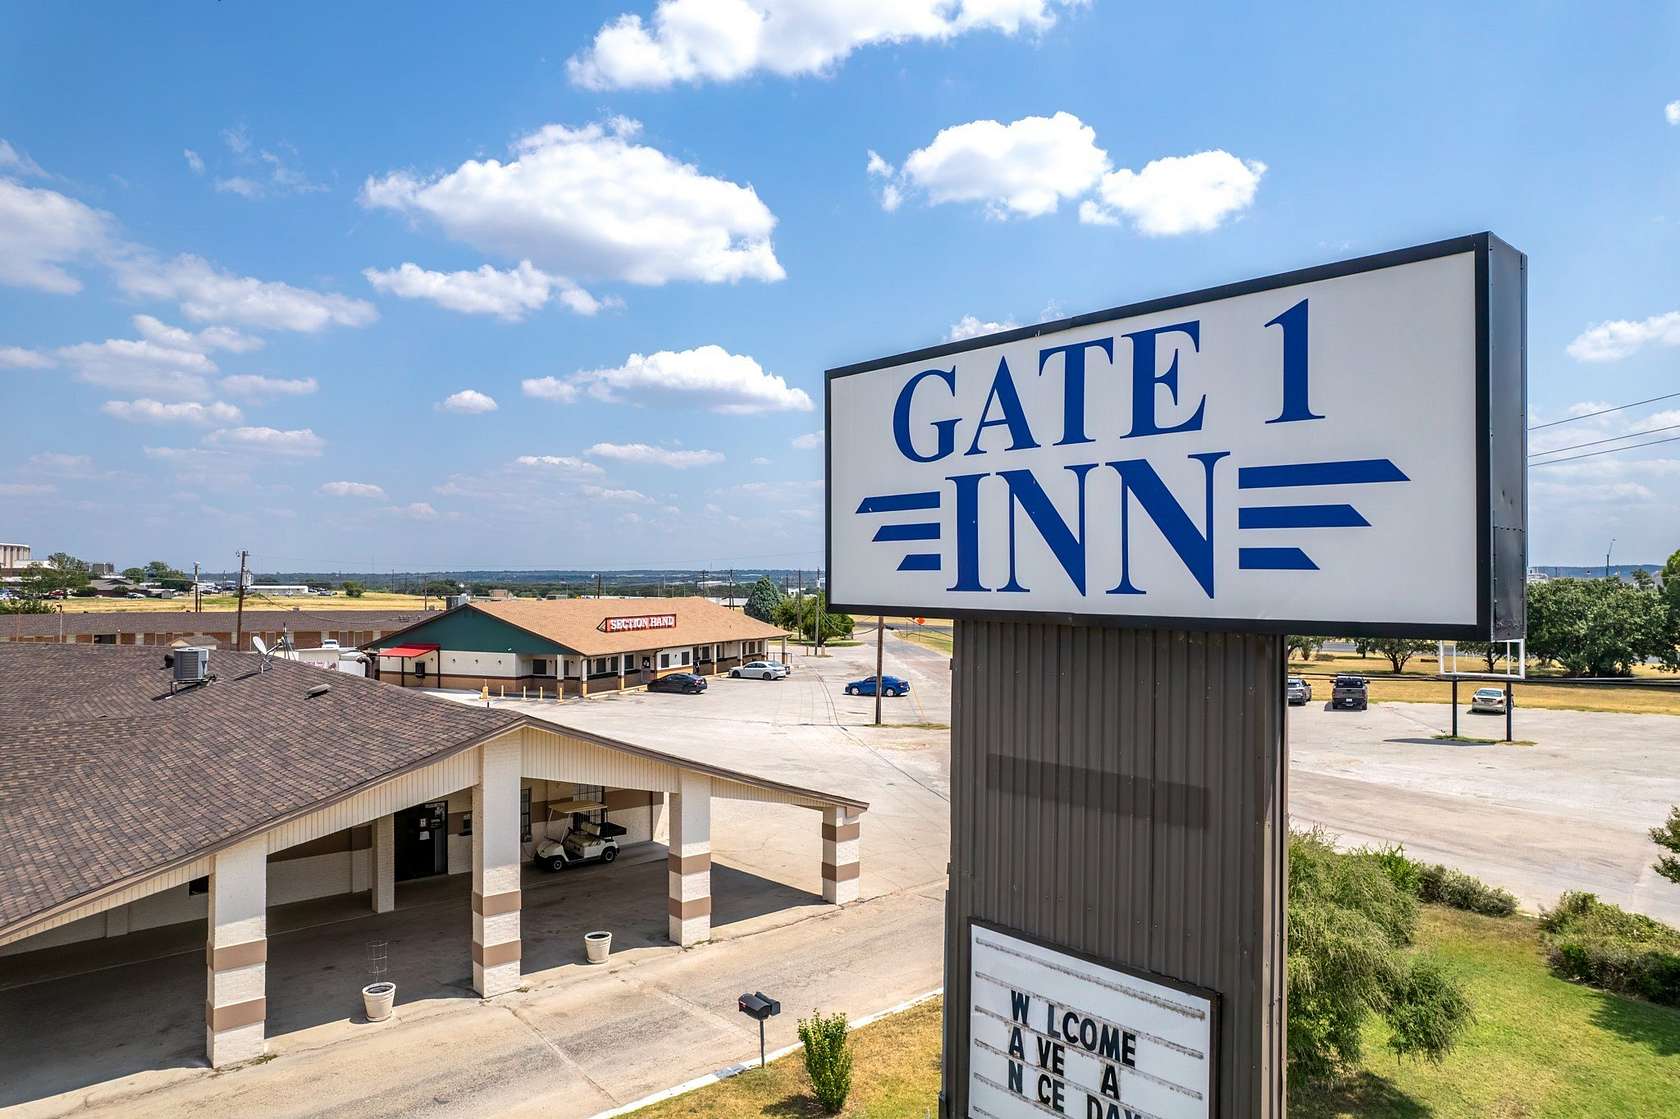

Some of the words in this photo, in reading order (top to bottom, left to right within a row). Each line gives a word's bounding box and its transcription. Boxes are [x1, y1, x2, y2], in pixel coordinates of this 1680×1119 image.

[893, 320, 1206, 463] GATE
[1264, 298, 1325, 424] 1
[945, 451, 1231, 599] INN
[610, 618, 647, 630] SECTION
[649, 617, 673, 627] HAND
[1101, 1064, 1120, 1099] A
